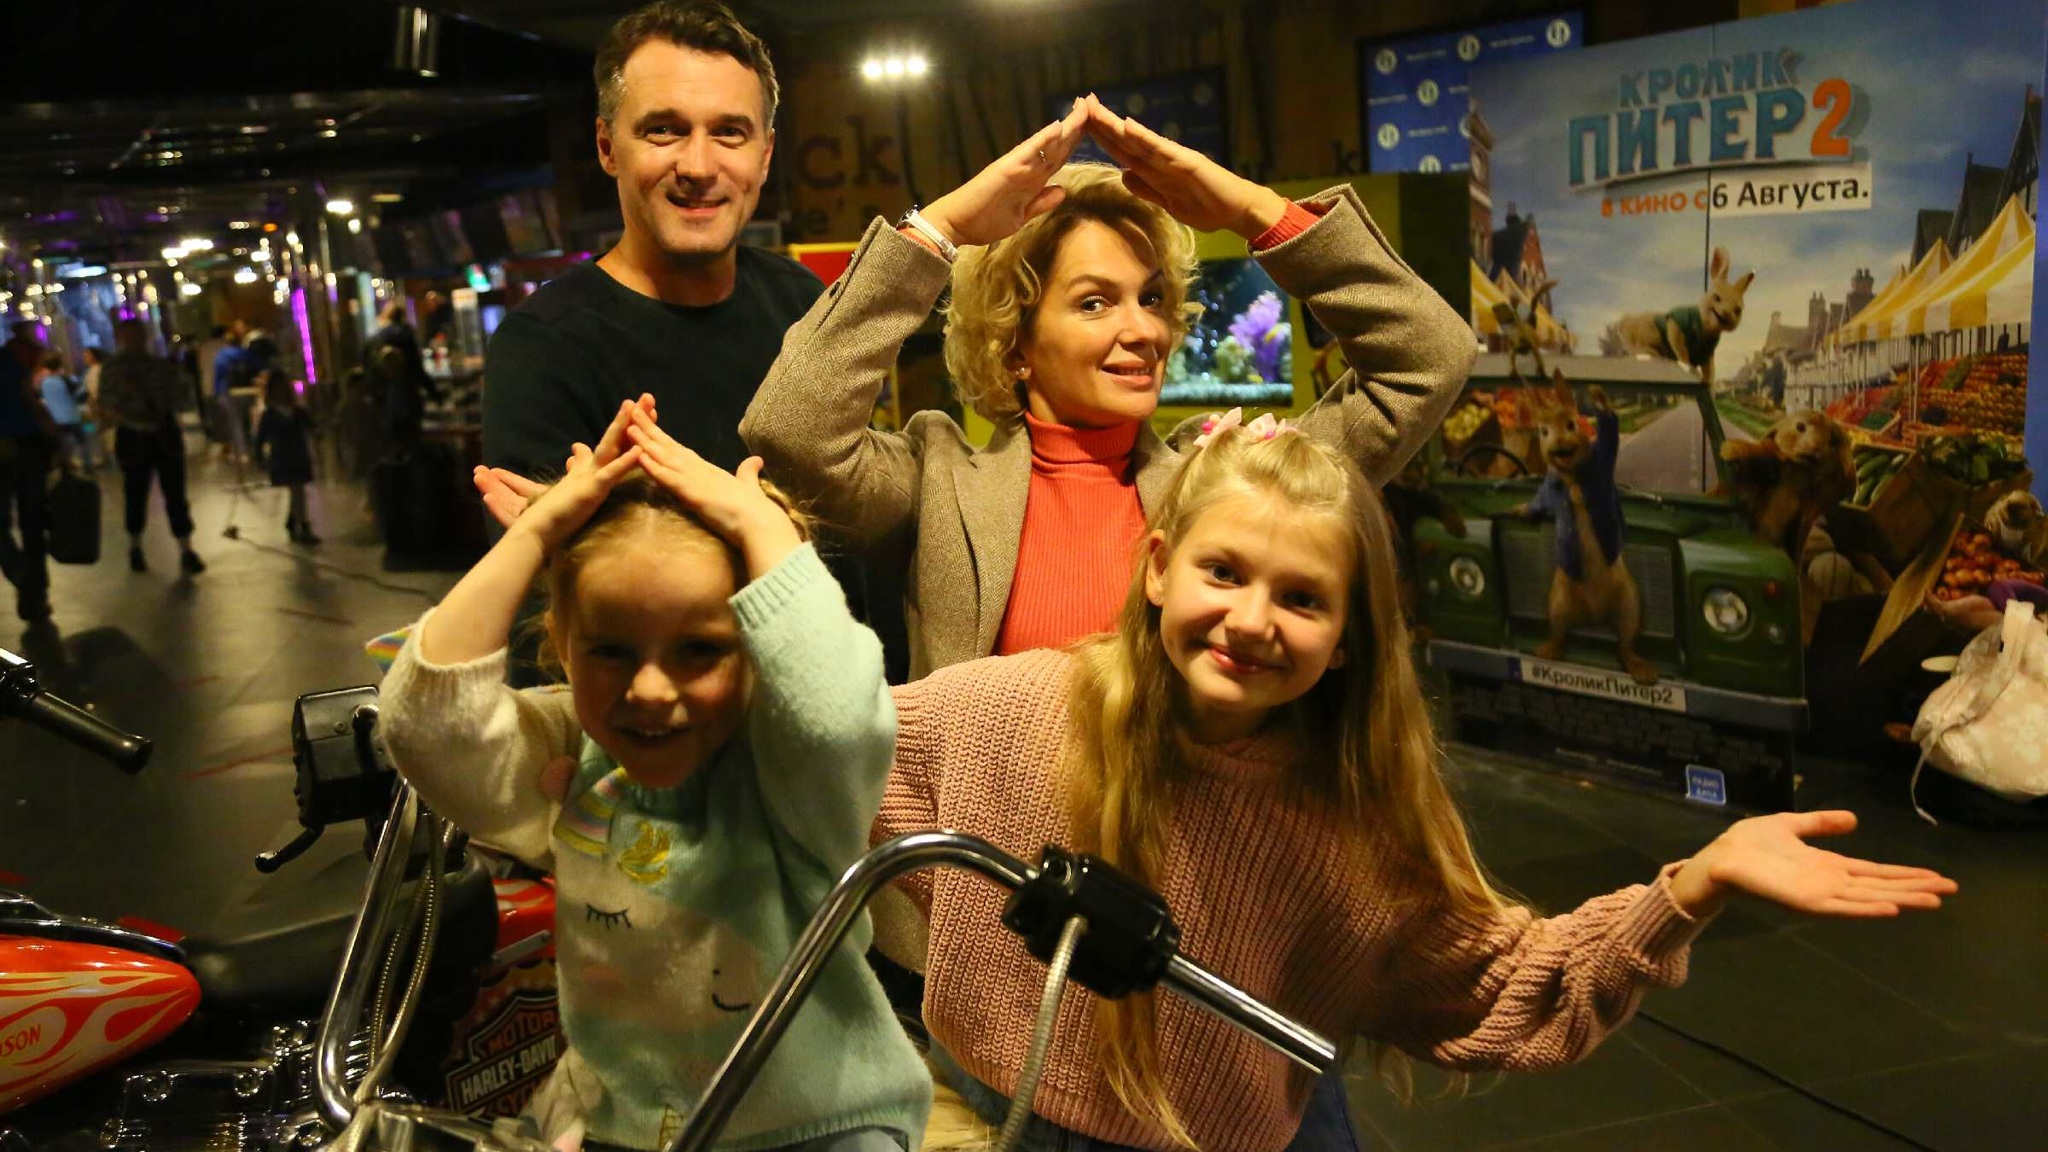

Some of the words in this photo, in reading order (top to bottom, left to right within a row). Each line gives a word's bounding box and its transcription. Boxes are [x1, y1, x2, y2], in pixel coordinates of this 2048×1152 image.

[1619, 48, 1800, 108] КРОЛИК
[1569, 87, 1806, 187] ПИТЕР
[1810, 78, 1852, 157] 2
[1712, 182, 1727, 209] 6
[1738, 178, 1869, 209] Августа.
[1532, 664, 1674, 705] #КроликПитер2
